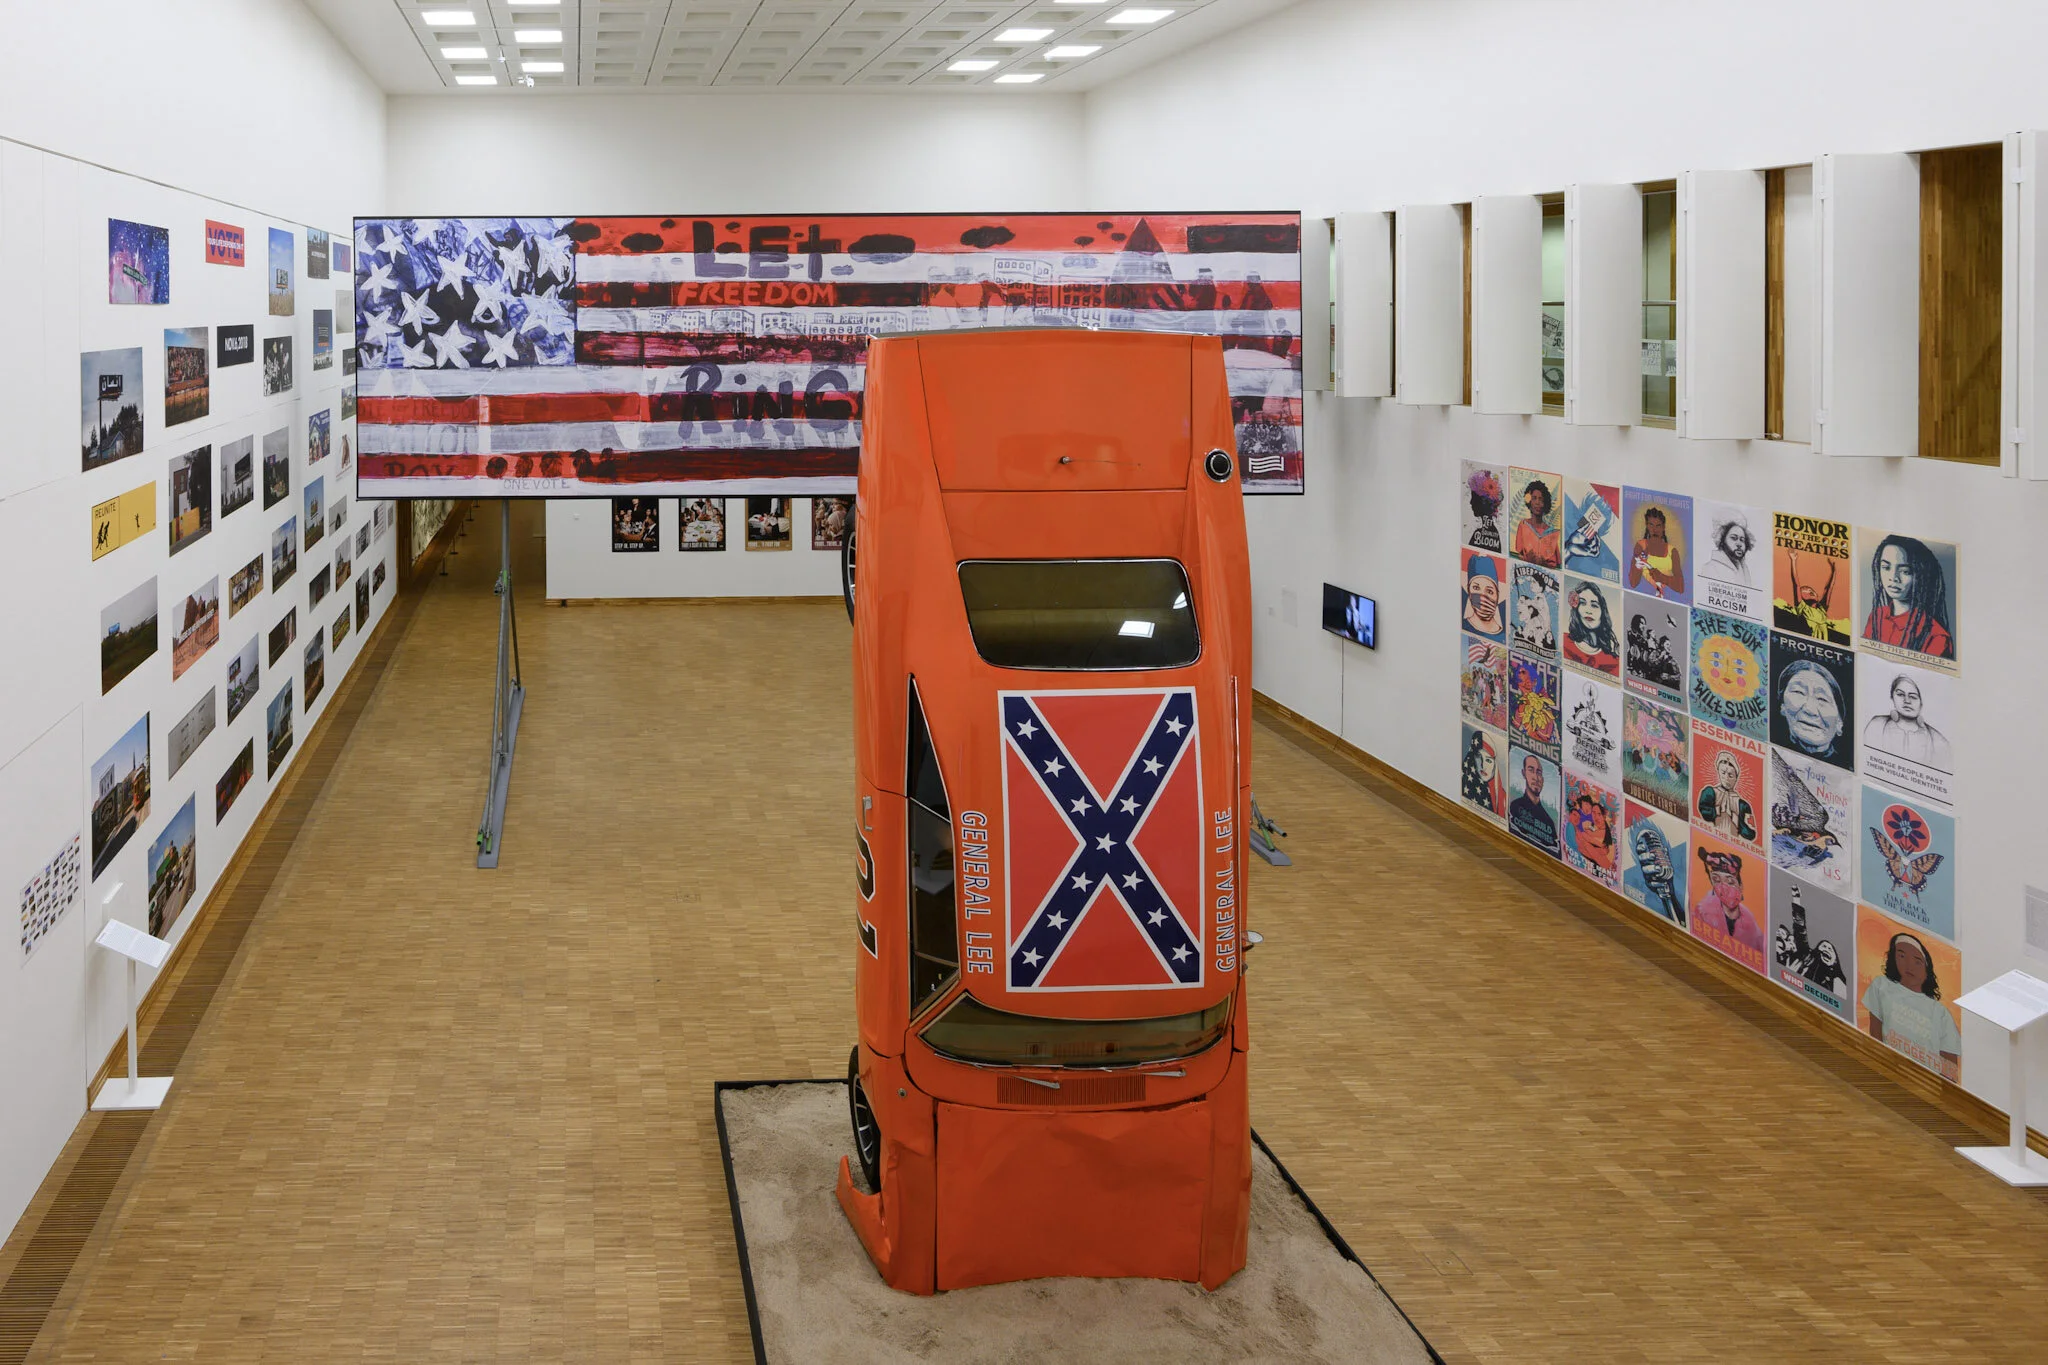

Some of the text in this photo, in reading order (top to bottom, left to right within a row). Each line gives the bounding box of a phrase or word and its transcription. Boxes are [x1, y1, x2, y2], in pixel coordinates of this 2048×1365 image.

[677, 282, 838, 306] FREEDOM
[95, 502, 117, 518] REUNITE
[1775, 514, 1848, 540] HONOR
[1801, 533, 1820, 543] THE
[1474, 532, 1500, 548] BLOOM
[1775, 536, 1849, 559] TREATIES
[1708, 586, 1747, 600] LIBERALISM
[1708, 596, 1747, 613] RACISM
[1694, 617, 1727, 636] THE
[1731, 622, 1763, 652] SUN
[1779, 636, 1843, 661] PROTECT
[1869, 641, 1884, 649] WE
[1887, 645, 1904, 654] THE
[1907, 650, 1946, 666] PEOPLE
[1627, 680, 1657, 695] WHO HAS
[1658, 690, 1682, 703] POWER
[1576, 737, 1605, 754] DEFUND
[1691, 718, 1766, 756] ESSENTIAL
[1576, 753, 1606, 769] POLICE
[1869, 755, 1943, 785] ENGAGE PEOPLE PAST
[1866, 762, 1948, 794] THEIR VISUAL IDENTITIES
[1566, 772, 1617, 809] VOTE
[1630, 783, 1677, 814] JUSTICE FIRST
[1829, 806, 1846, 818] CAN
[1714, 829, 1729, 840] THE
[1730, 835, 1766, 857] HEALERS
[1823, 867, 1841, 881] US
[961, 809, 993, 974] GENERAL LEE
[1214, 807, 1237, 972] GENERAL LEE
[1693, 916, 1763, 966] BREATHE
[1783, 971, 1803, 989] WHO
[1804, 984, 1840, 1009] DECIDES
